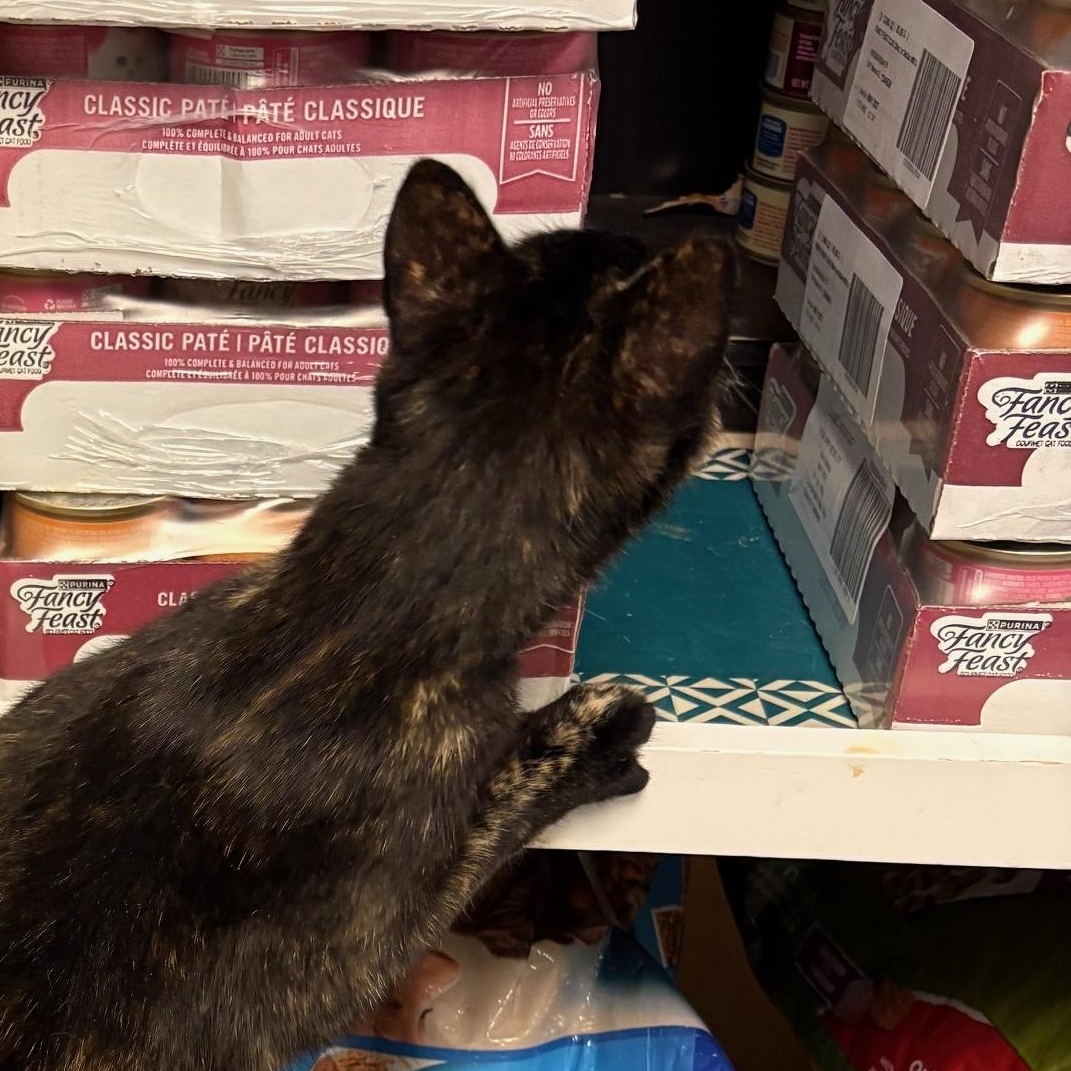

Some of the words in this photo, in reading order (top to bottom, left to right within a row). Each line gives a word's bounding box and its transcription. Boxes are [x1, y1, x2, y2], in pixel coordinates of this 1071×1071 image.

[5, 77, 44, 88] PURINA
[537, 82, 552, 96] NO
[84, 94, 172, 118] CLASSIC
[181, 94, 229, 118] PATÉ
[242, 96, 295, 125] PÂTÉ
[303, 96, 426, 122] CLASSIQUE
[161, 127, 184, 138] 100%
[186, 128, 226, 139] COMPLETE
[233, 132, 273, 144] BALANCED
[275, 131, 292, 143] FOR
[293, 130, 320, 142] ADULT
[321, 130, 342, 140] CATS
[529, 124, 554, 138] SANS
[142, 139, 185, 151] COMPLÈTE
[185, 141, 197, 151] ET
[248, 147, 270, 157] 100%
[272, 145, 295, 155] POUR
[296, 144, 323, 154] CHATS
[324, 143, 361, 154] ADULTES
[90, 331, 174, 351] CLASSIC
[182, 329, 230, 351] PATÉ
[248, 330, 296, 354] PÂTÉ
[304, 336, 390, 356] CLASSIQ
[164, 358, 185, 368] 100%
[187, 358, 227, 368] COMPLETE
[236, 359, 277, 370] BALANCED
[278, 361, 293, 370] FOR
[244, 369, 250, 380] À
[251, 371, 273, 381] 100%
[274, 372, 296, 382] POUR
[991, 387, 1071, 421] Fanc
[1000, 414, 1071, 444] Feas
[70, 581, 106, 589] PURINA
[17, 584, 107, 613] Fancy
[31, 606, 104, 630] Feast
[1000, 622, 1040, 630] PURINA
[937, 624, 1039, 655] Fancy
[947, 647, 1029, 672] Feast
